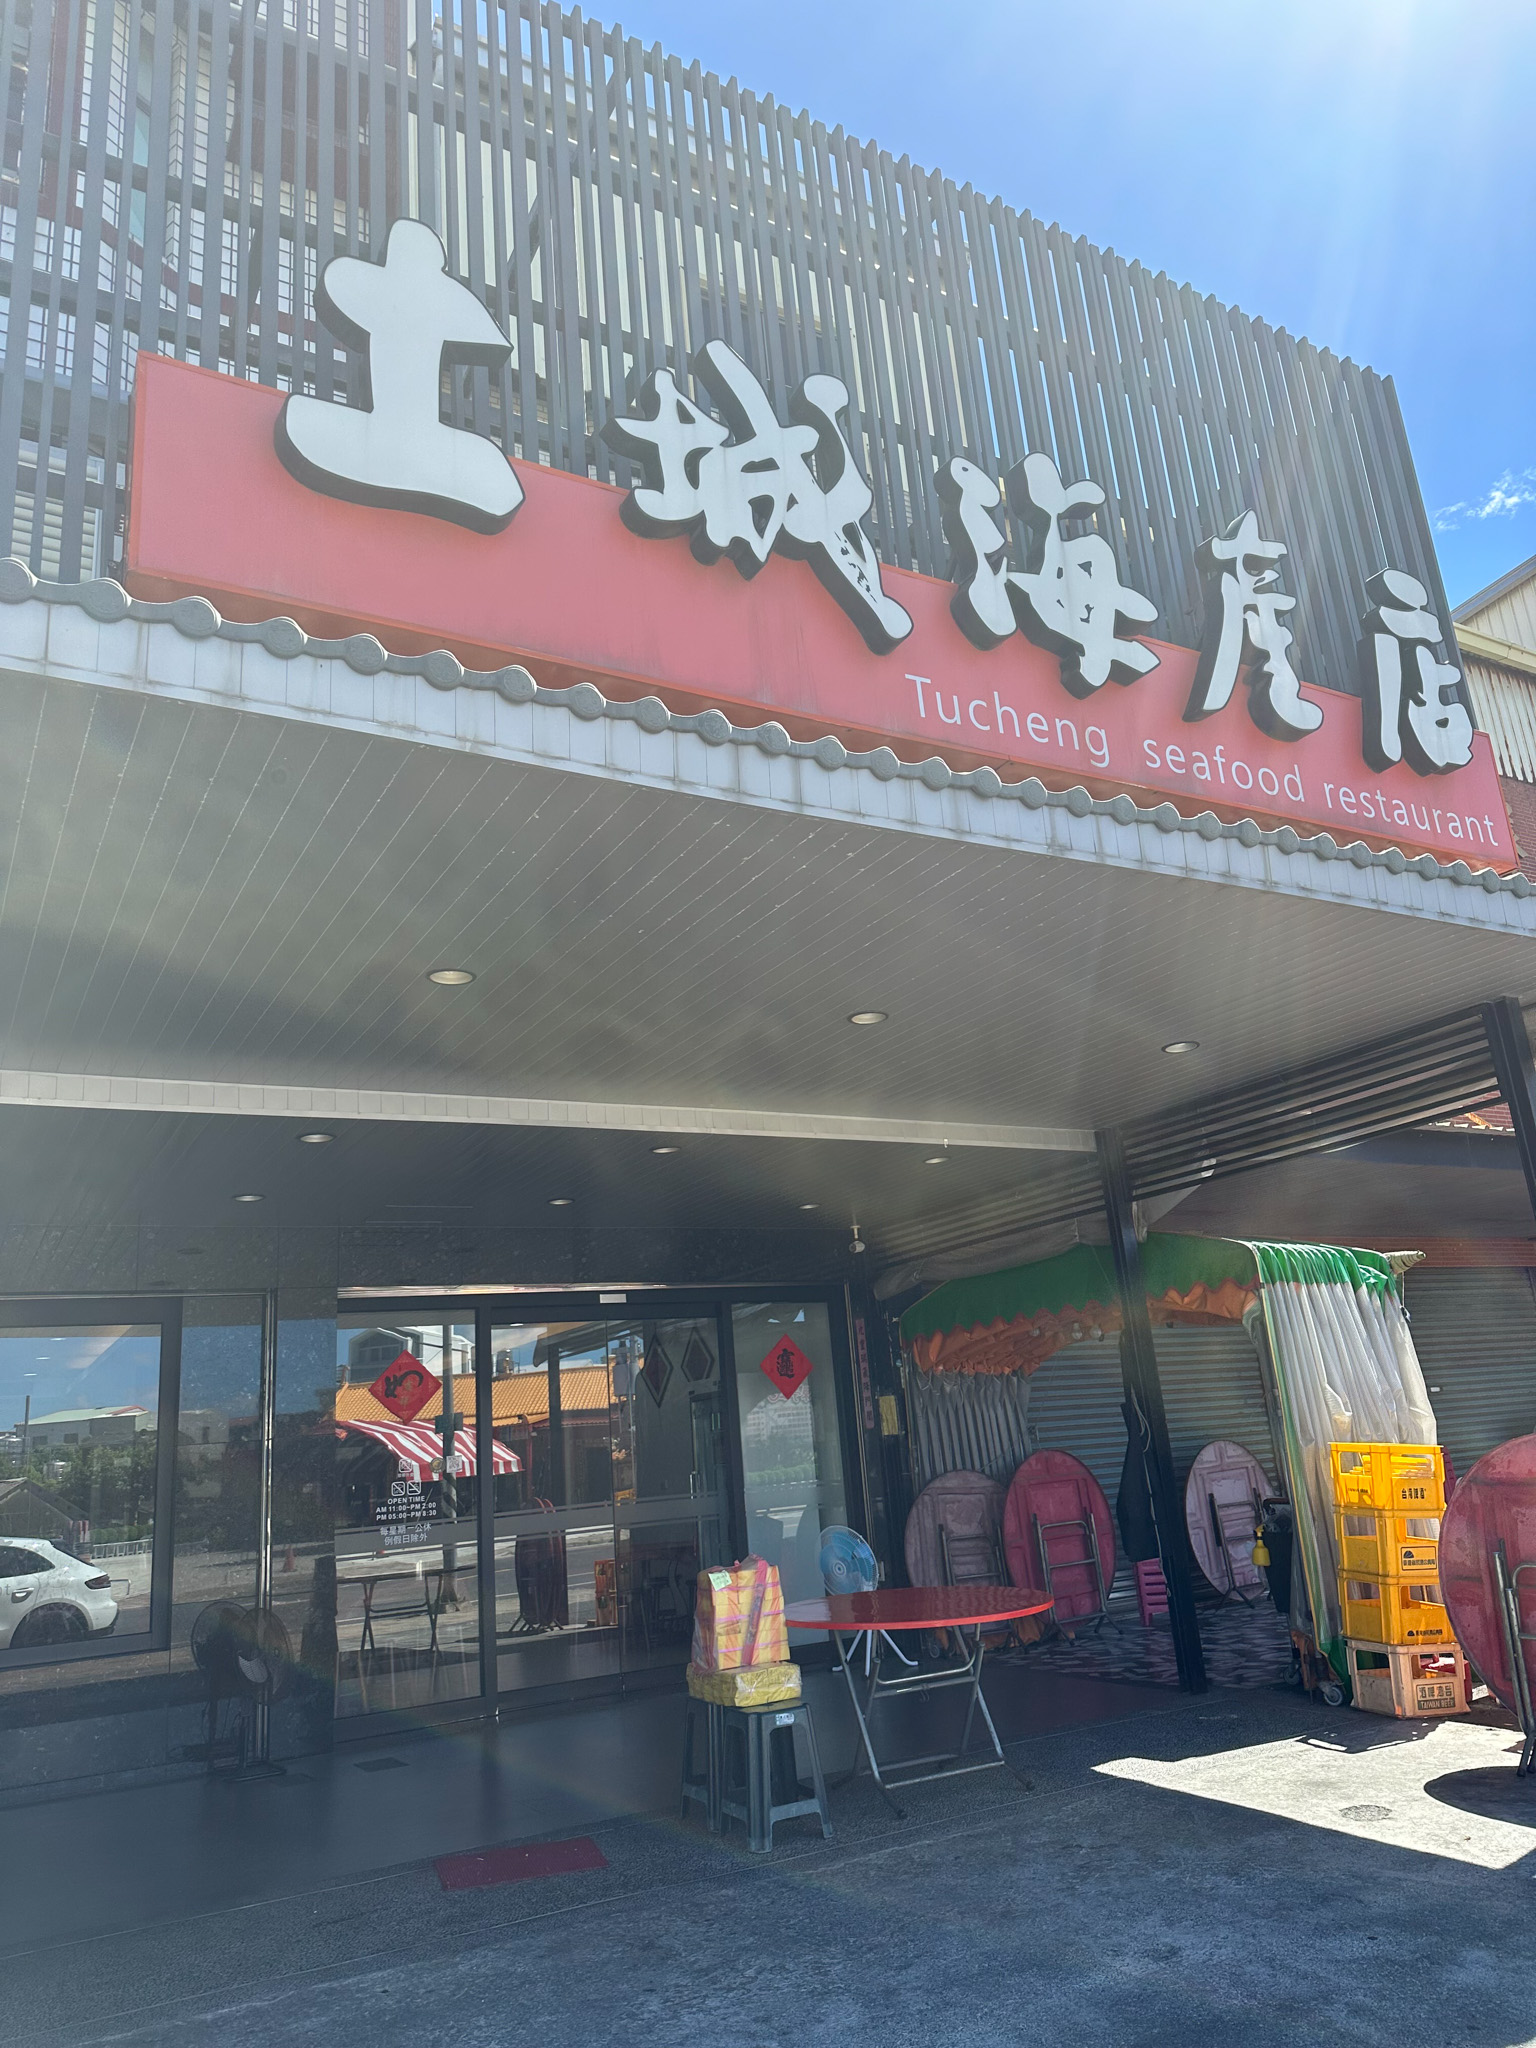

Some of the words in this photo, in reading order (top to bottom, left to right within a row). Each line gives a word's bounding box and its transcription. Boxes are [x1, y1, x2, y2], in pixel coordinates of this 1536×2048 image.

[905, 673, 1110, 768] Tucheng
[1144, 736, 1306, 803] seafood
[1323, 780, 1499, 847] restaurant
[387, 1497, 407, 1505] OPEN
[422, 1509, 437, 1517] 8:30
[380, 1523, 432, 1536] 每星期一公休
[384, 1533, 428, 1545] 例假日除外
[1420, 1700, 1440, 1709] TAIWAN
[1440, 1699, 1454, 1708] BEER
